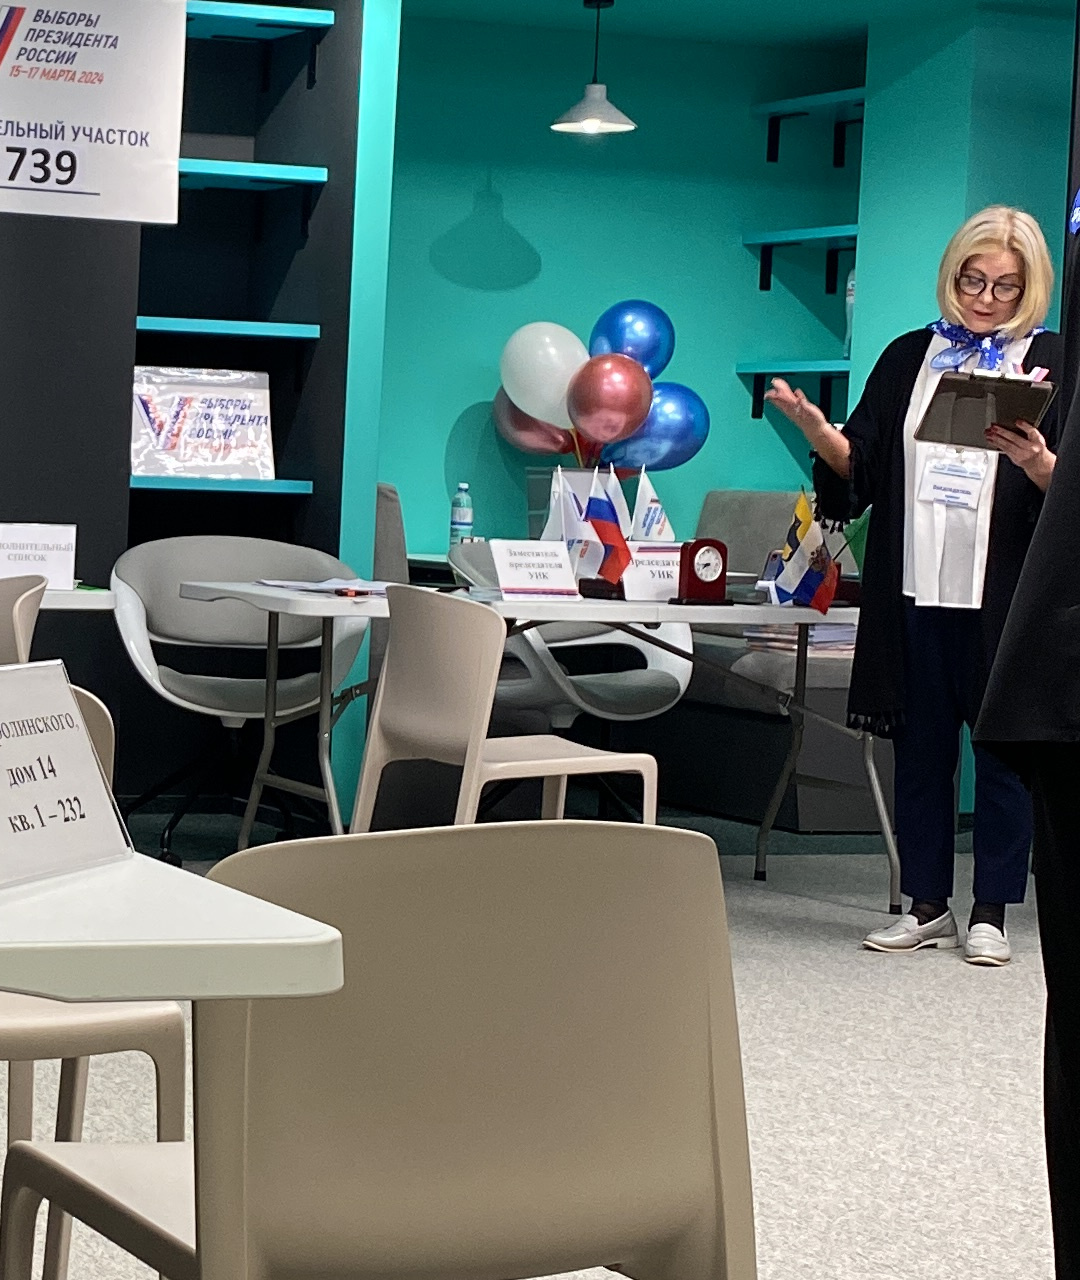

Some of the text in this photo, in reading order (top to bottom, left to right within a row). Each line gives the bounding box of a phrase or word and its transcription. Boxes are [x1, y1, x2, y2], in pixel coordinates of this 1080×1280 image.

[32, 9, 100, 28] ВЫБОРЫ
[24, 28, 119, 50] ПРЕЗИДЕНТА
[16, 47, 77, 65] РОССИИ
[41, 67, 76, 83] МАРТА
[77, 70, 104, 85] 2024
[71, 126, 150, 148] УЧАСТОК
[5, 146, 78, 186] 739
[7, 553, 47, 562] СПИСОК
[528, 571, 549, 580] УИК
[650, 569, 674, 579] УИК
[6, 754, 58, 789] дом 14
[8, 814, 36, 833] кв.
[33, 803, 47, 828] 1
[57, 795, 86, 823] 232
